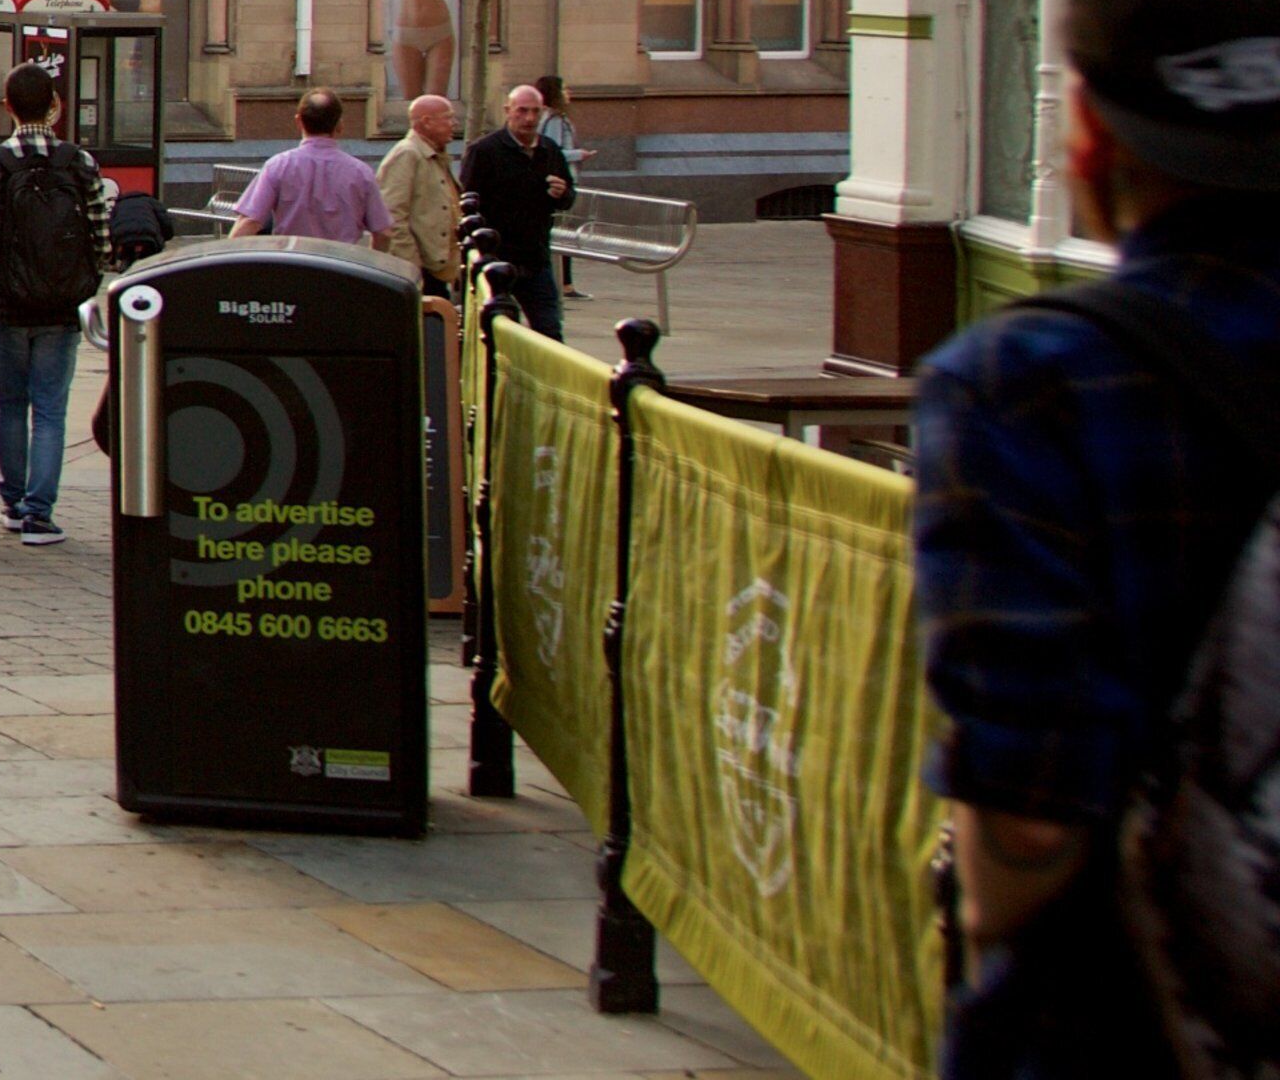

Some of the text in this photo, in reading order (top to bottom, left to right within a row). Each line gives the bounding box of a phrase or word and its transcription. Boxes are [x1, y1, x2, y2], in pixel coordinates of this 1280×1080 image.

[218, 300, 297, 316] BigBelly
[192, 496, 375, 527] To advertise
[197, 534, 372, 568] here please
[237, 574, 333, 603] phone
[184, 610, 389, 643] 0845 600 6663
